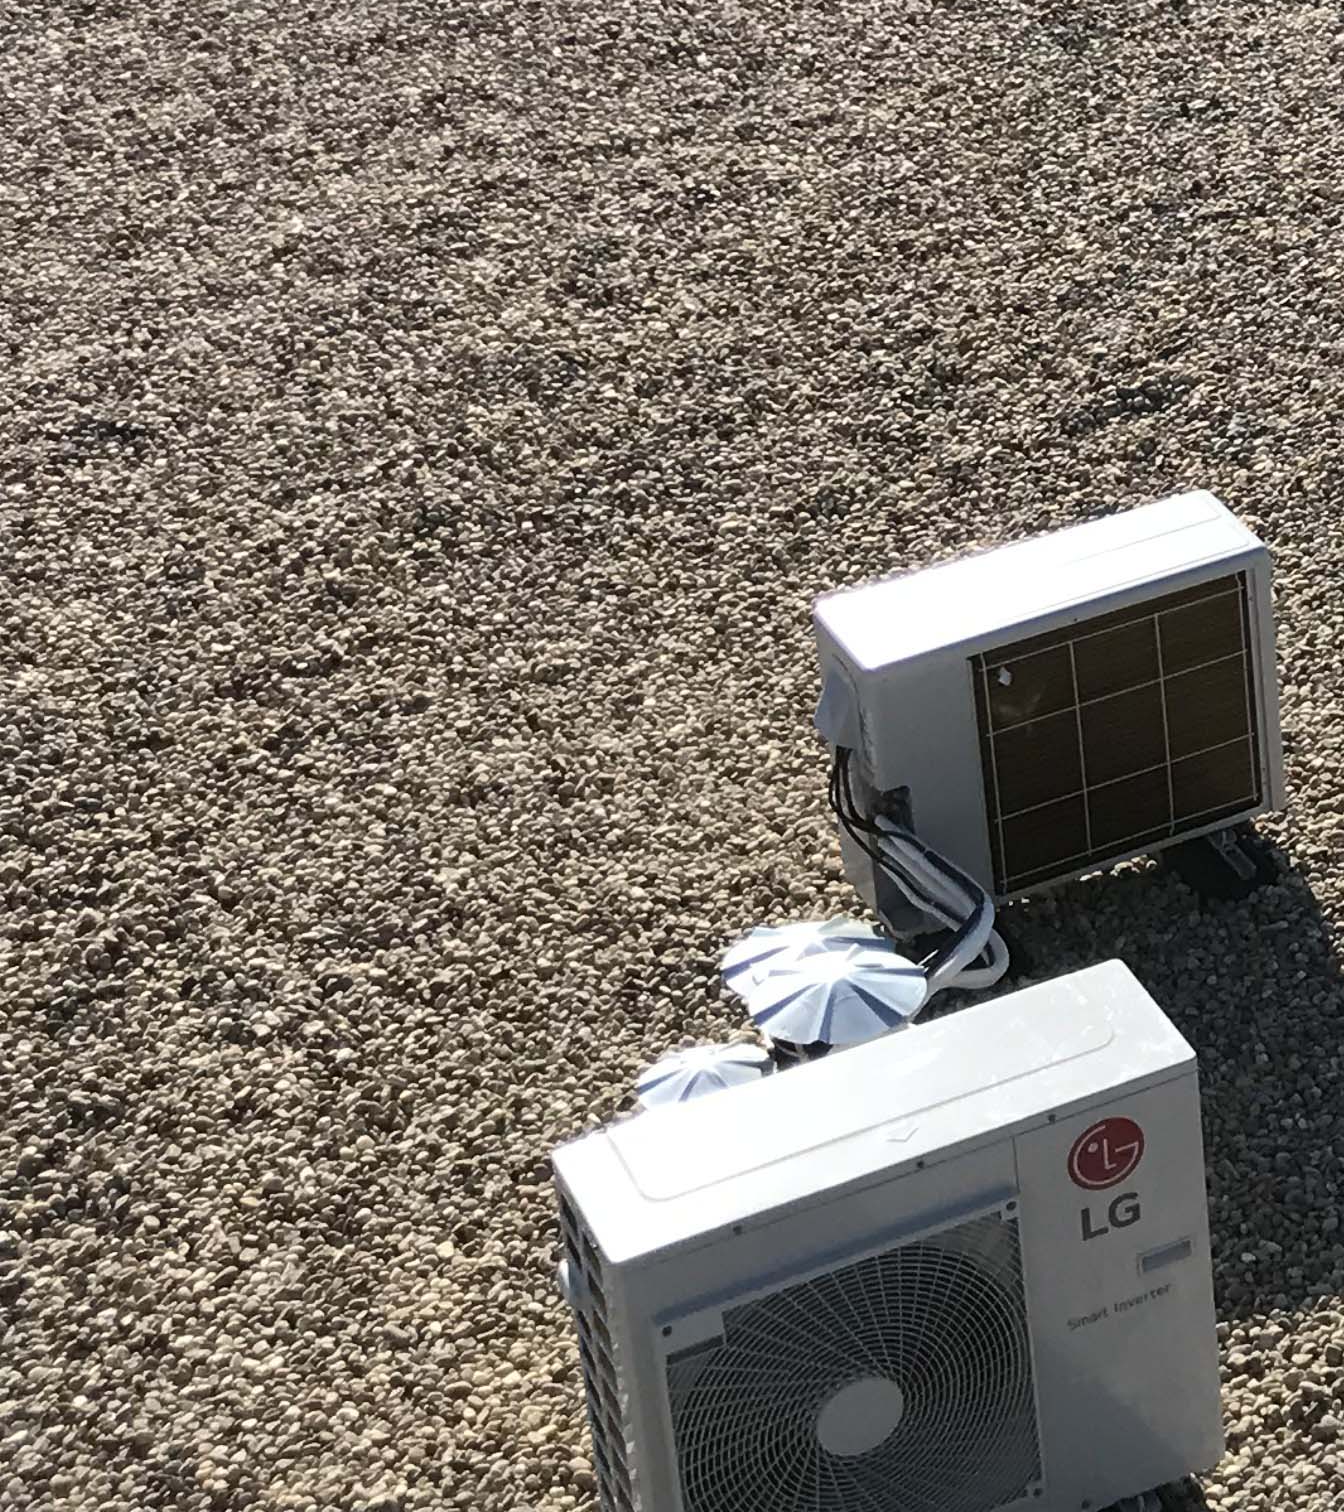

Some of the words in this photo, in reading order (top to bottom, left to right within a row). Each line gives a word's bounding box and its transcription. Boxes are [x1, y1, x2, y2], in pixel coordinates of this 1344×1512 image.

[1080, 1191, 1141, 1241] LG
[1066, 1306, 1109, 1331] Smart
[1113, 1282, 1172, 1313] Inverter
